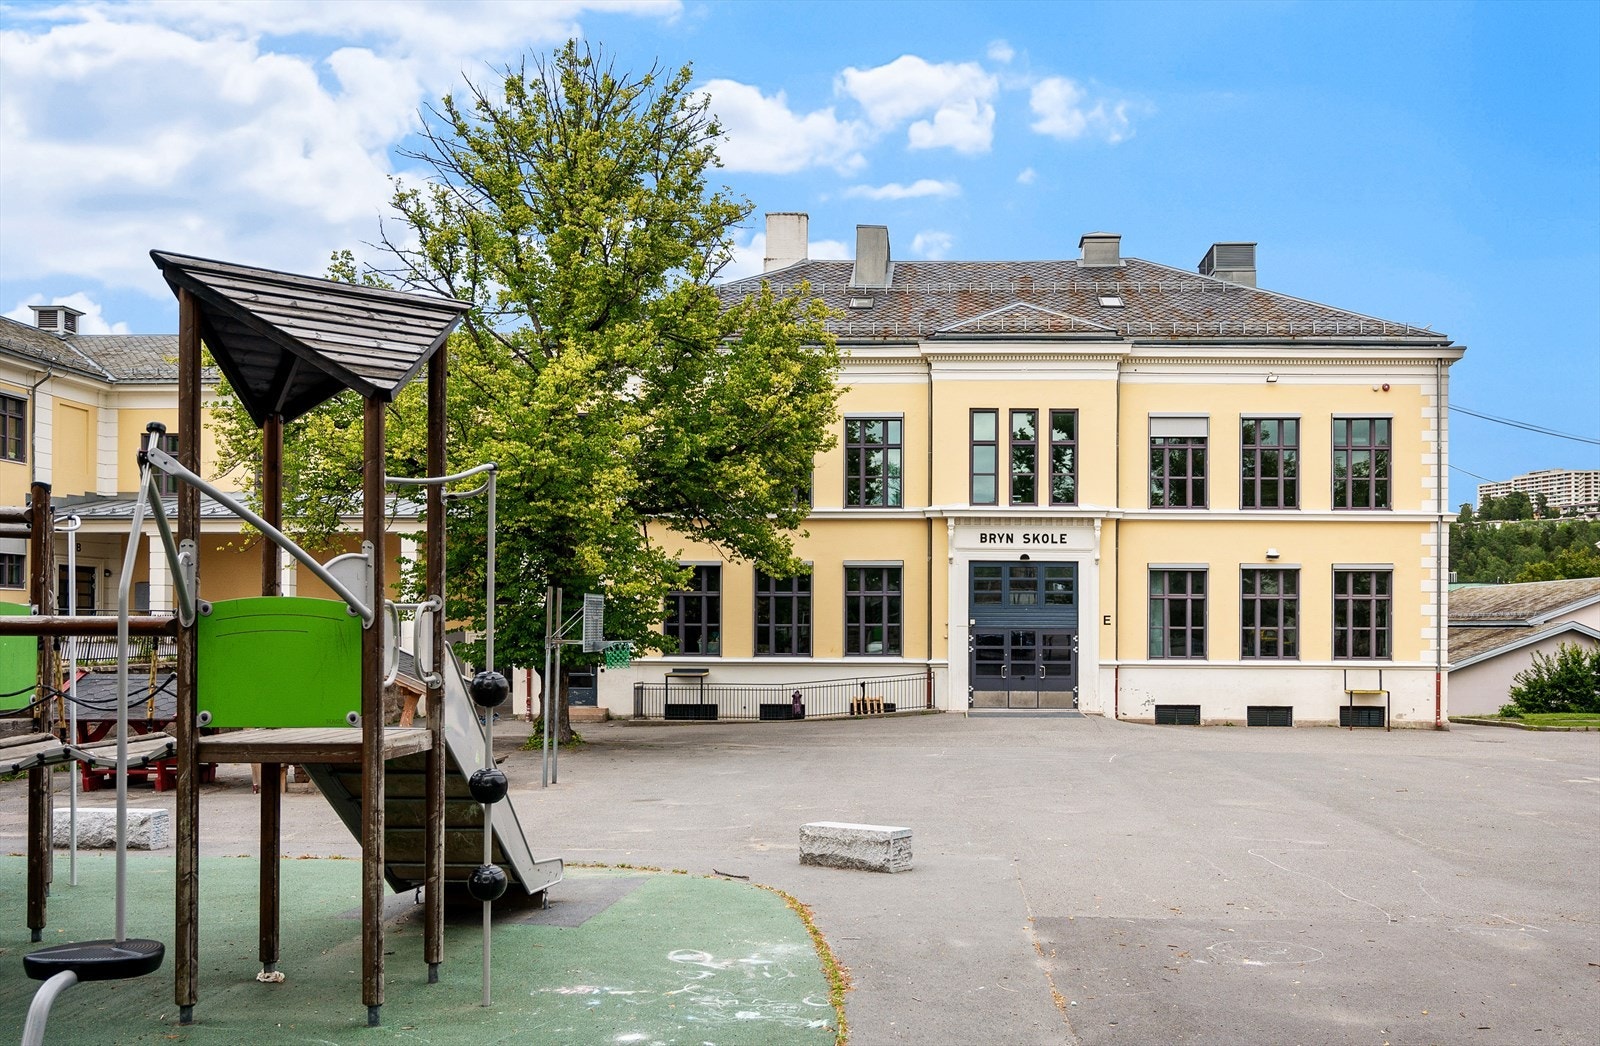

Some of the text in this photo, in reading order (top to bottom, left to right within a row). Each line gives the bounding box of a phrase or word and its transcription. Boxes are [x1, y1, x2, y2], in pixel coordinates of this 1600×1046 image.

[980, 533, 1067, 543] BRYN SKOLE
[76, 543, 82, 552] B
[1103, 615, 1111, 625] E
